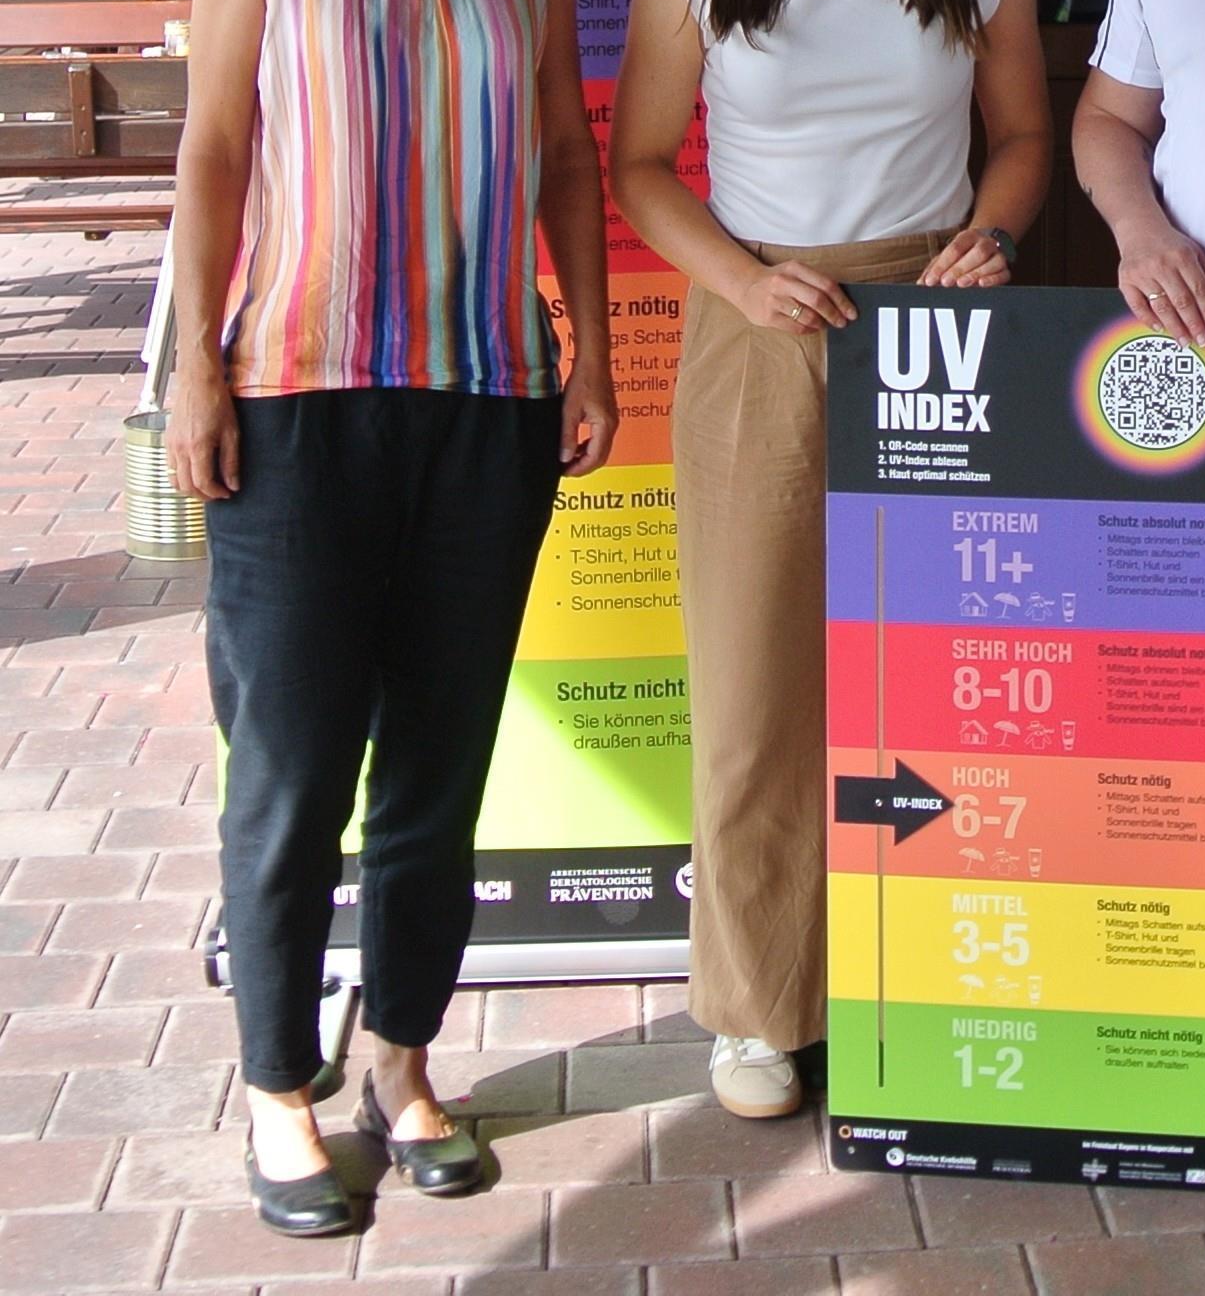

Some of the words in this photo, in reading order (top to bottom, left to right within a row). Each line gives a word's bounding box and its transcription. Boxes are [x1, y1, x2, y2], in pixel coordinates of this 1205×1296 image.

[628, 296, 680, 319] nötig
[878, 307, 992, 391] UV
[630, 356, 660, 371] Hut
[877, 392, 991, 433] INDEX
[878, 440, 887, 451] 1.
[888, 440, 929, 452] QR-Code
[930, 442, 969, 453] scannen
[878, 454, 887, 465] 2.
[889, 454, 931, 466] UV-Index
[932, 456, 968, 467] ablesen
[878, 468, 887, 479] 3.
[889, 468, 911, 480] Haut
[912, 470, 947, 482] optimal
[948, 470, 991, 482] schützen
[554, 490, 624, 511] Schutz
[952, 511, 1039, 534] EXTREM
[1098, 515, 1138, 528] Schutz
[1142, 516, 1186, 529] absolut
[570, 522, 632, 541] Mittags
[570, 548, 628, 564] T-Shirt,
[633, 547, 662, 562] Hut
[953, 537, 1034, 584] 11+
[570, 567, 672, 586] Sonnenbrille
[951, 638, 1012, 661] SEHR
[1015, 640, 1073, 664] HOCH
[1098, 644, 1138, 657] Schutz
[1142, 645, 1186, 658] absolut
[557, 681, 627, 702] Schutz
[634, 678, 686, 699] nicht
[952, 666, 1053, 714] 8-10
[573, 713, 600, 729] Sie
[604, 713, 665, 728] können
[573, 733, 641, 750] draußen
[952, 766, 1010, 789] HOCH
[1097, 773, 1137, 787] Schutz
[1141, 774, 1172, 788] nötig
[893, 796, 943, 811] UV-INDEX
[951, 793, 1028, 840] 6-7
[550, 867, 653, 877] ARBEITSGEMEINSCHAFT
[550, 876, 653, 887] DERMATOLOGISCHE
[550, 885, 654, 903] PRÄVENTION
[952, 893, 1030, 917] MITTEL
[1097, 899, 1137, 913] Schutz
[1140, 900, 1170, 915] nötig
[952, 919, 1030, 968] 3-5
[952, 1017, 1038, 1042] NIEDRIG
[1096, 1026, 1137, 1039] Schutz
[1140, 1028, 1170, 1041] nicht
[1173, 1029, 1203, 1044] nötig
[953, 1043, 1024, 1091] 1-2
[852, 1127, 887, 1141] WATCH
[887, 1129, 908, 1142] OUT
